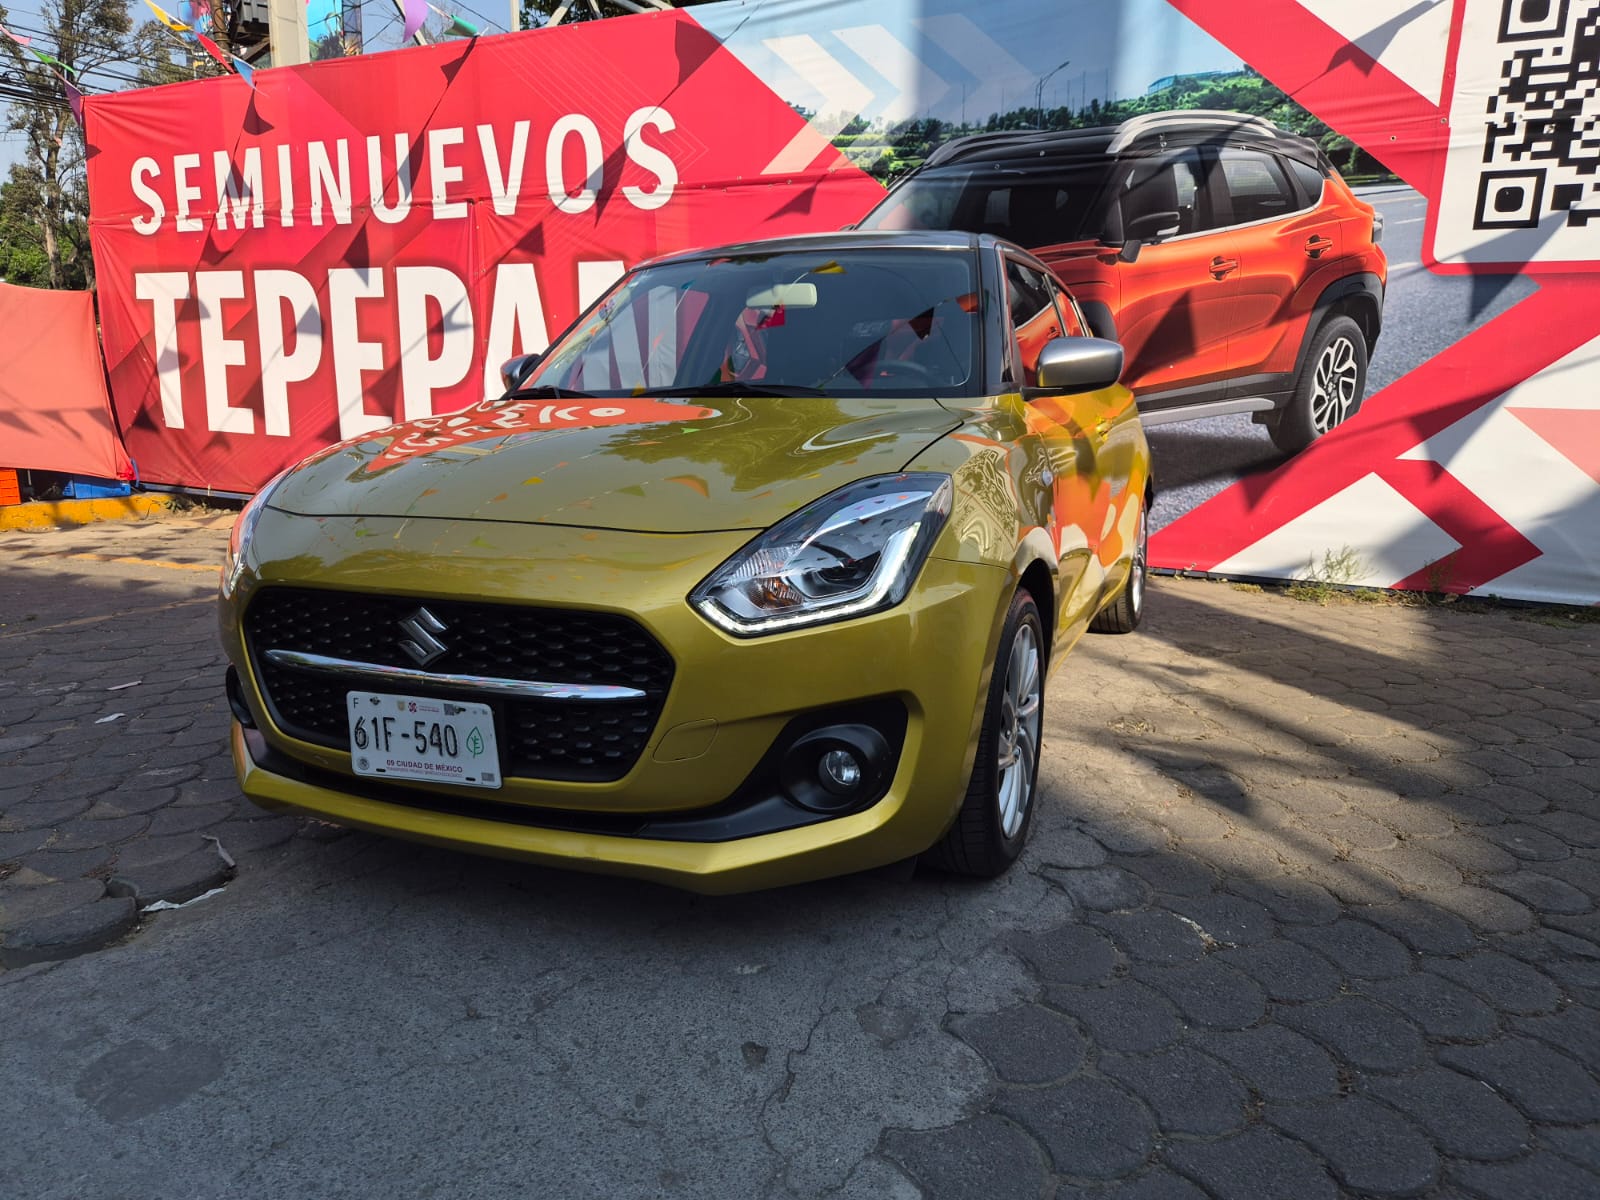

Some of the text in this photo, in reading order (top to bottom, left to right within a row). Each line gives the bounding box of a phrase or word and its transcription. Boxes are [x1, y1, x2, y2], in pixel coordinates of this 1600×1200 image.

[130, 106, 679, 236] SEMINUEVOS
[354, 715, 459, 759] 61F-540
[396, 760, 423, 769] CIUDAD
